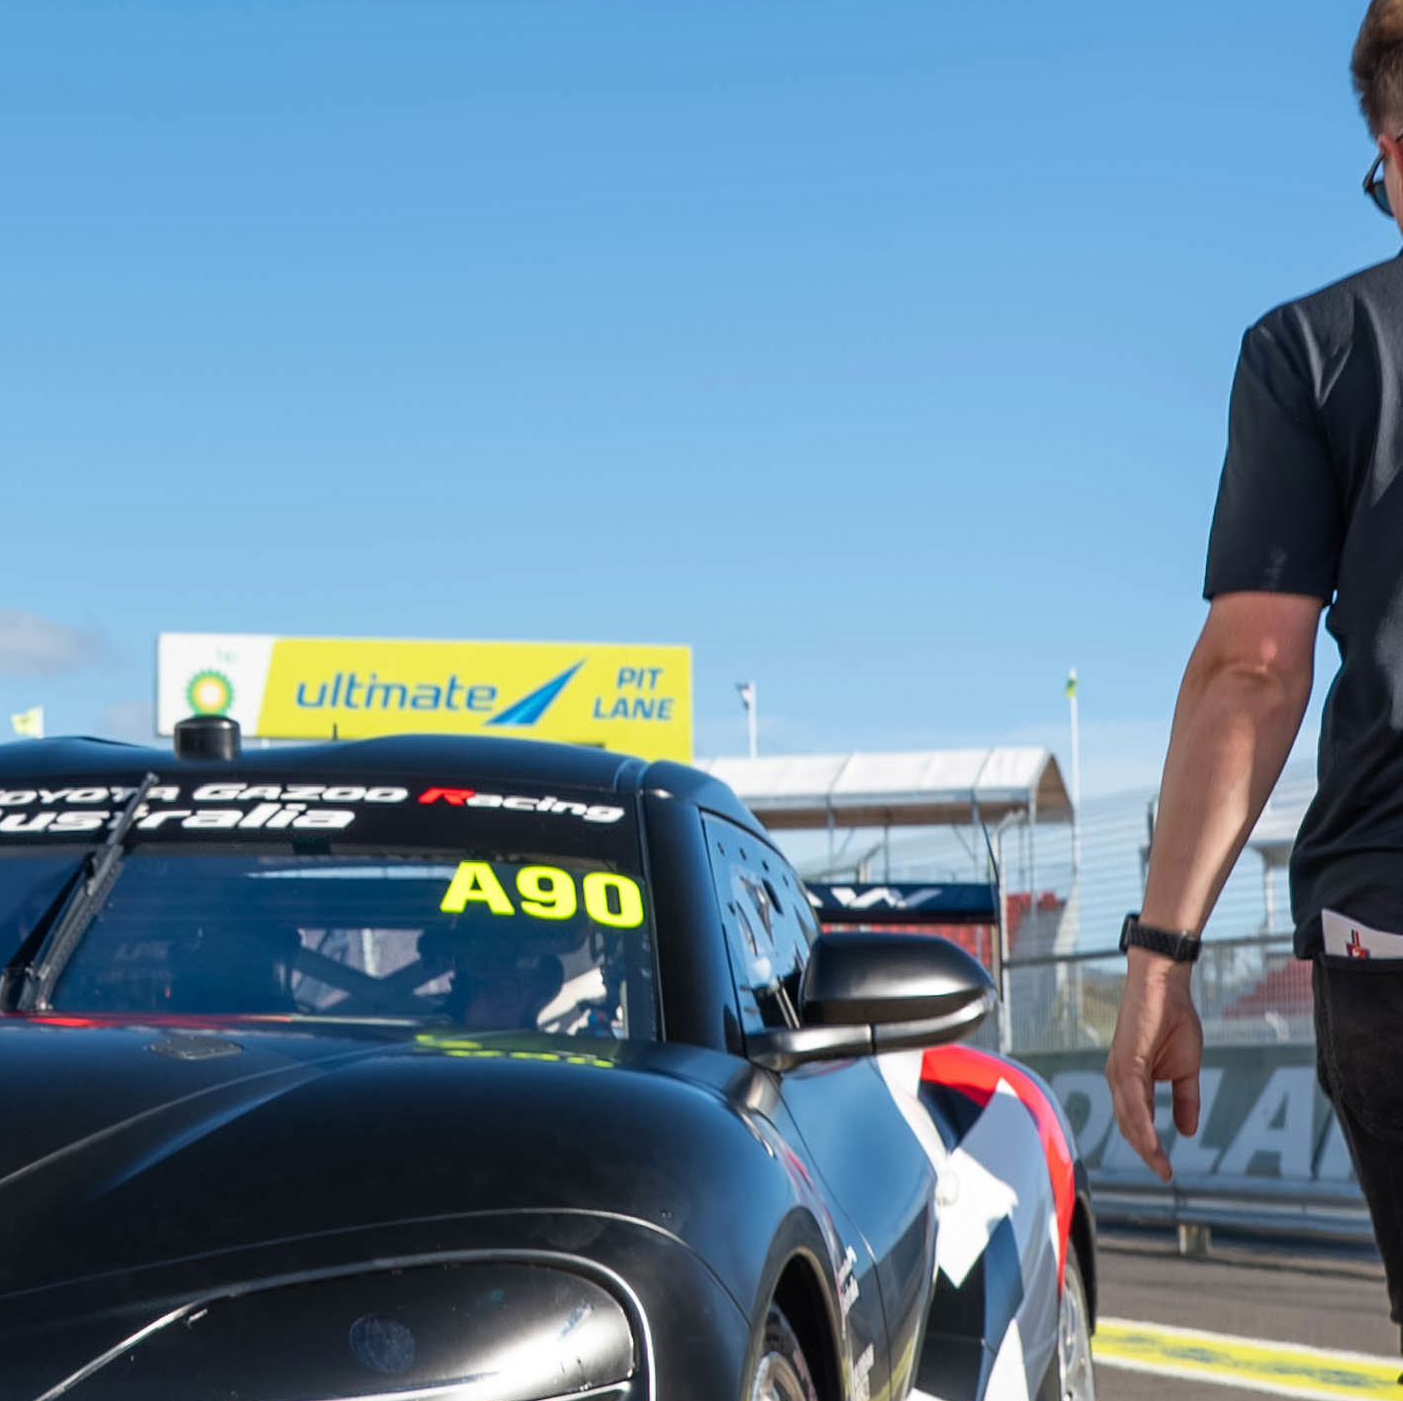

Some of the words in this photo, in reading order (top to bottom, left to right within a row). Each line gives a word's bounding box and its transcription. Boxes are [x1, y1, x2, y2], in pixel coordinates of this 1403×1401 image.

[296, 671, 499, 712] ultimate
[616, 666, 664, 690] PIT
[592, 696, 674, 721] LANE
[417, 786, 626, 824] Racing
[439, 859, 644, 929] A90
